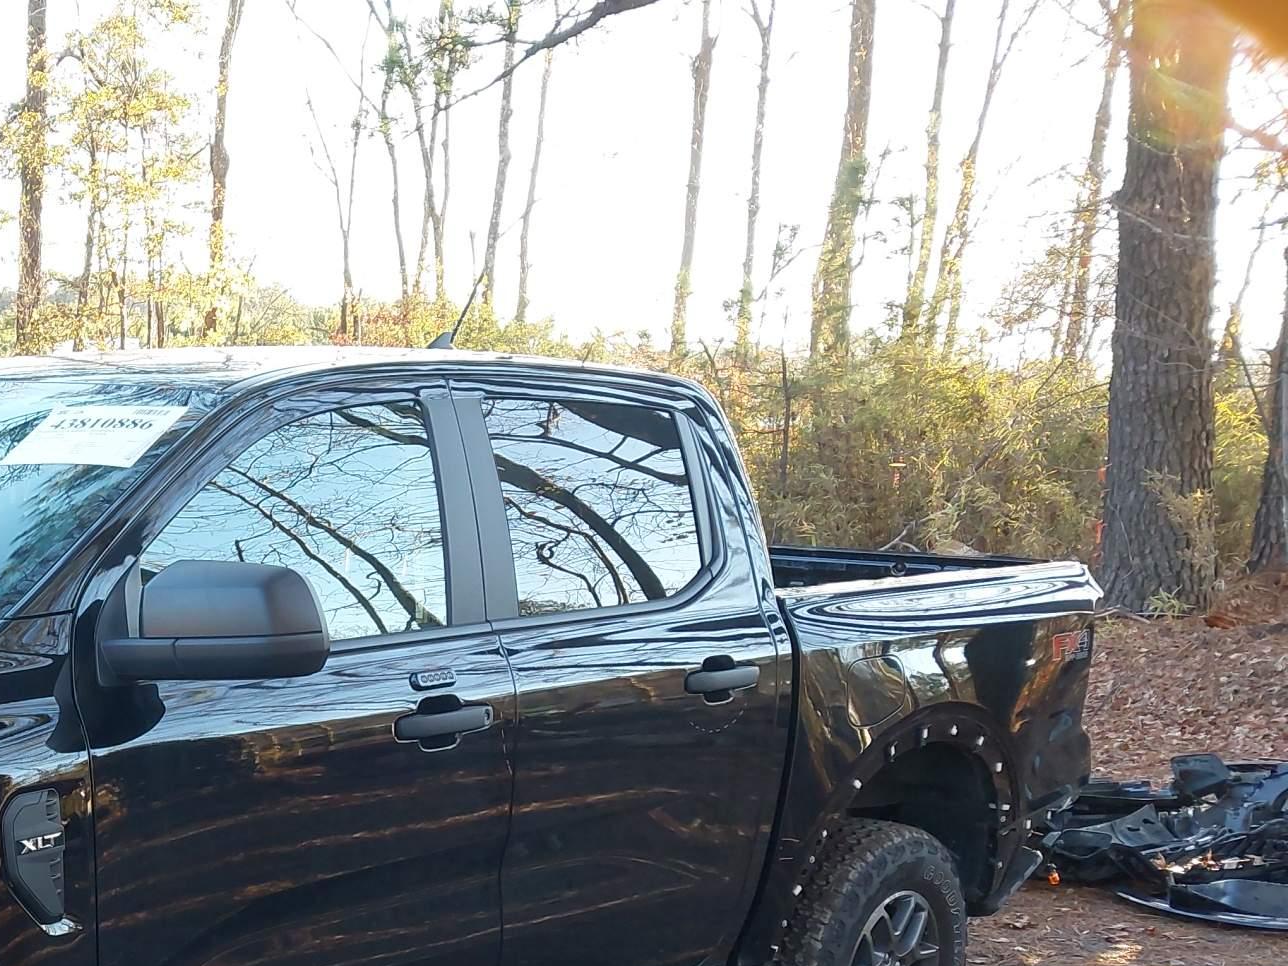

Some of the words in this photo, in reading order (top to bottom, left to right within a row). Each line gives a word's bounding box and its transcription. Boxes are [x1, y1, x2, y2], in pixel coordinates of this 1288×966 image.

[49, 417, 155, 430] 43810886
[1052, 628, 1090, 661] FX4
[19, 831, 62, 855] XLT
